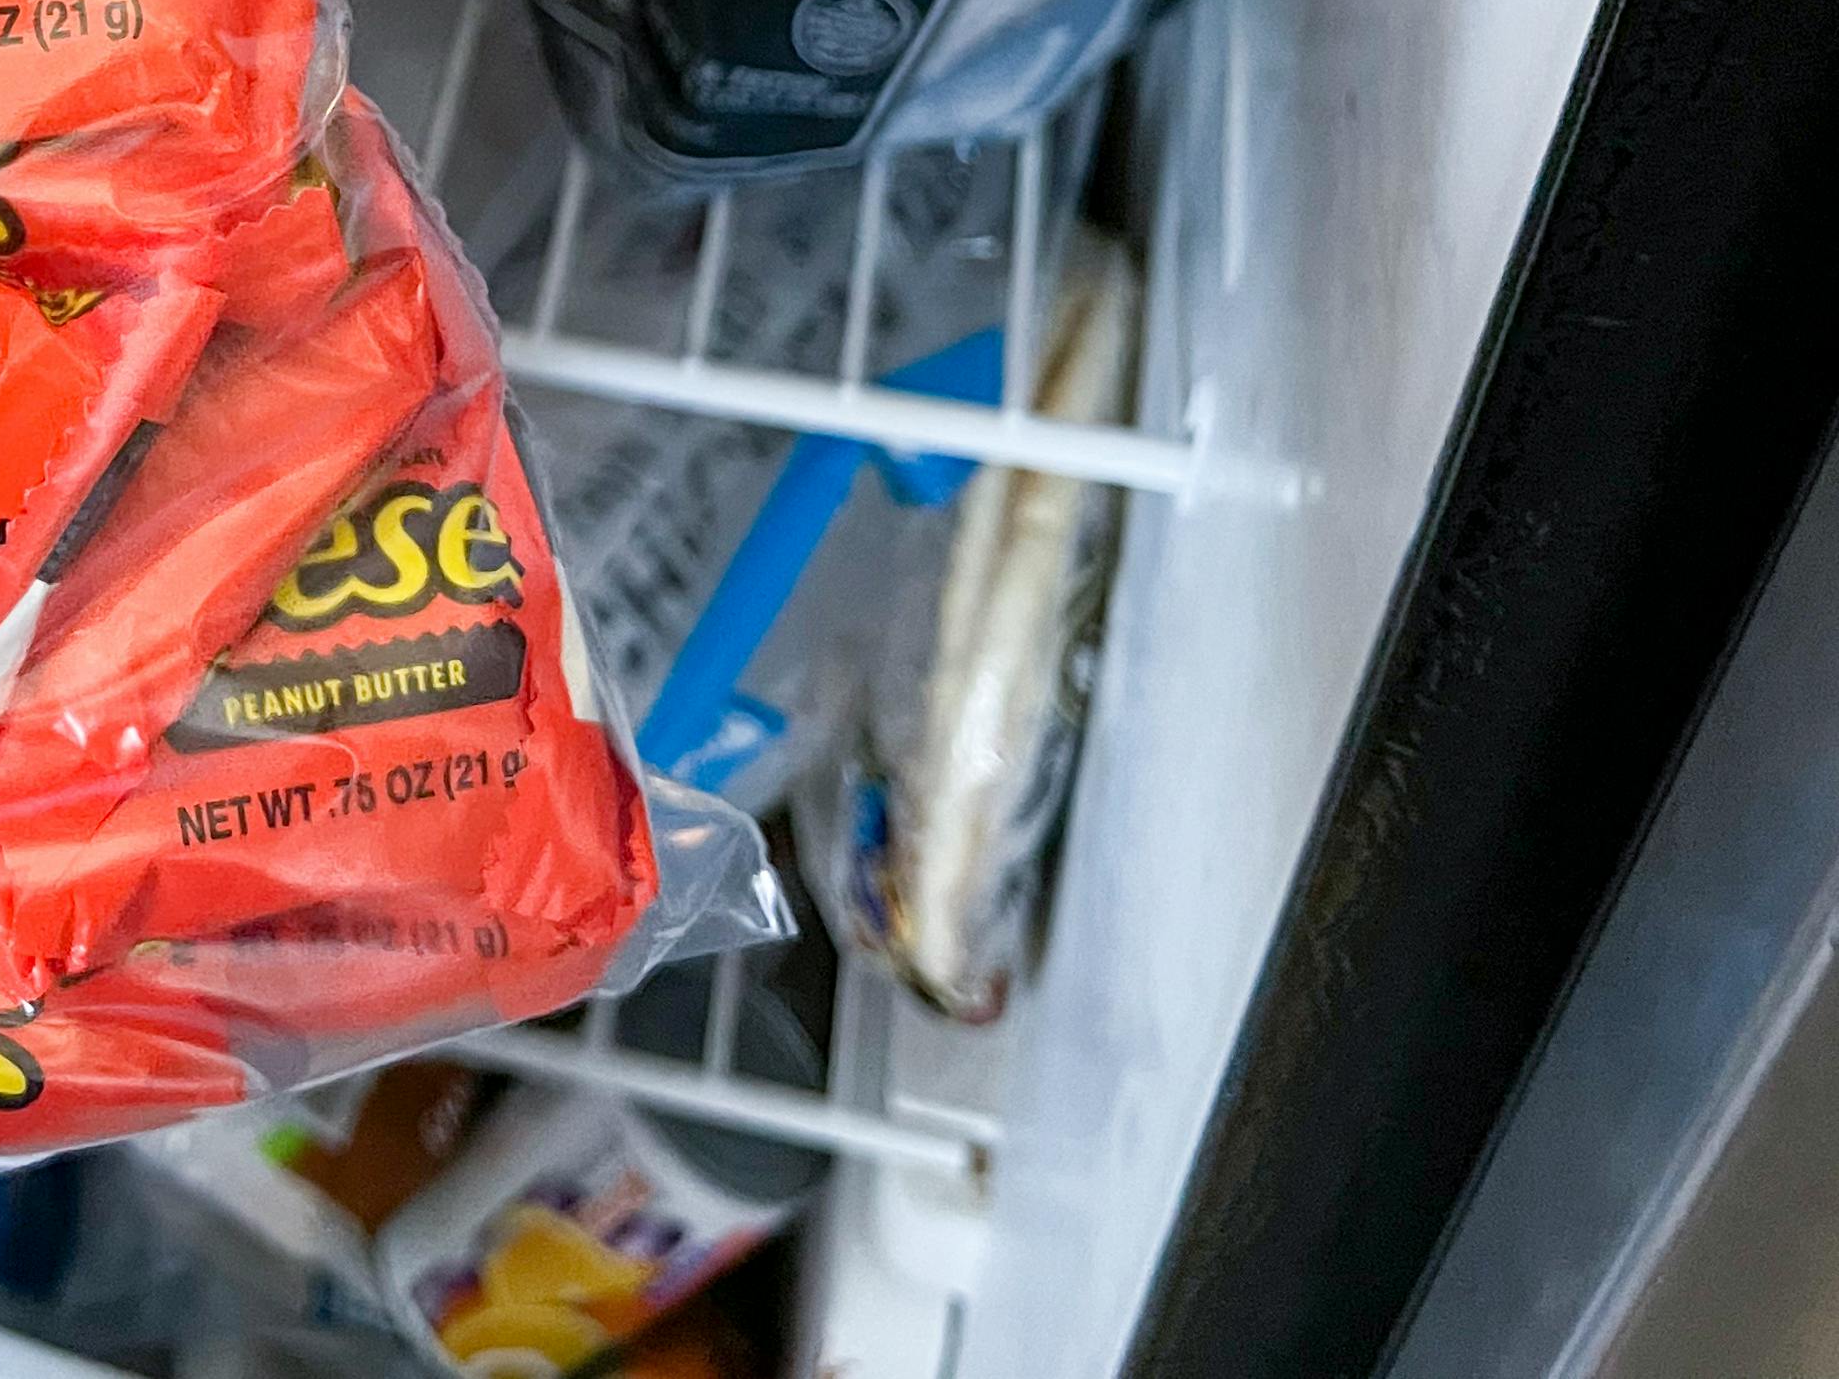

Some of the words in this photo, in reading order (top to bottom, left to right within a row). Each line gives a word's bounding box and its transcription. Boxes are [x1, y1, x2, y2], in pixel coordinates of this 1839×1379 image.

[223, 678, 343, 729] PEANUT
[353, 657, 467, 706] BUTTER
[176, 794, 252, 847] NET
[257, 782, 317, 829] WT
[328, 772, 377, 819] .75
[385, 759, 436, 805] OZ
[442, 750, 489, 801] (21
